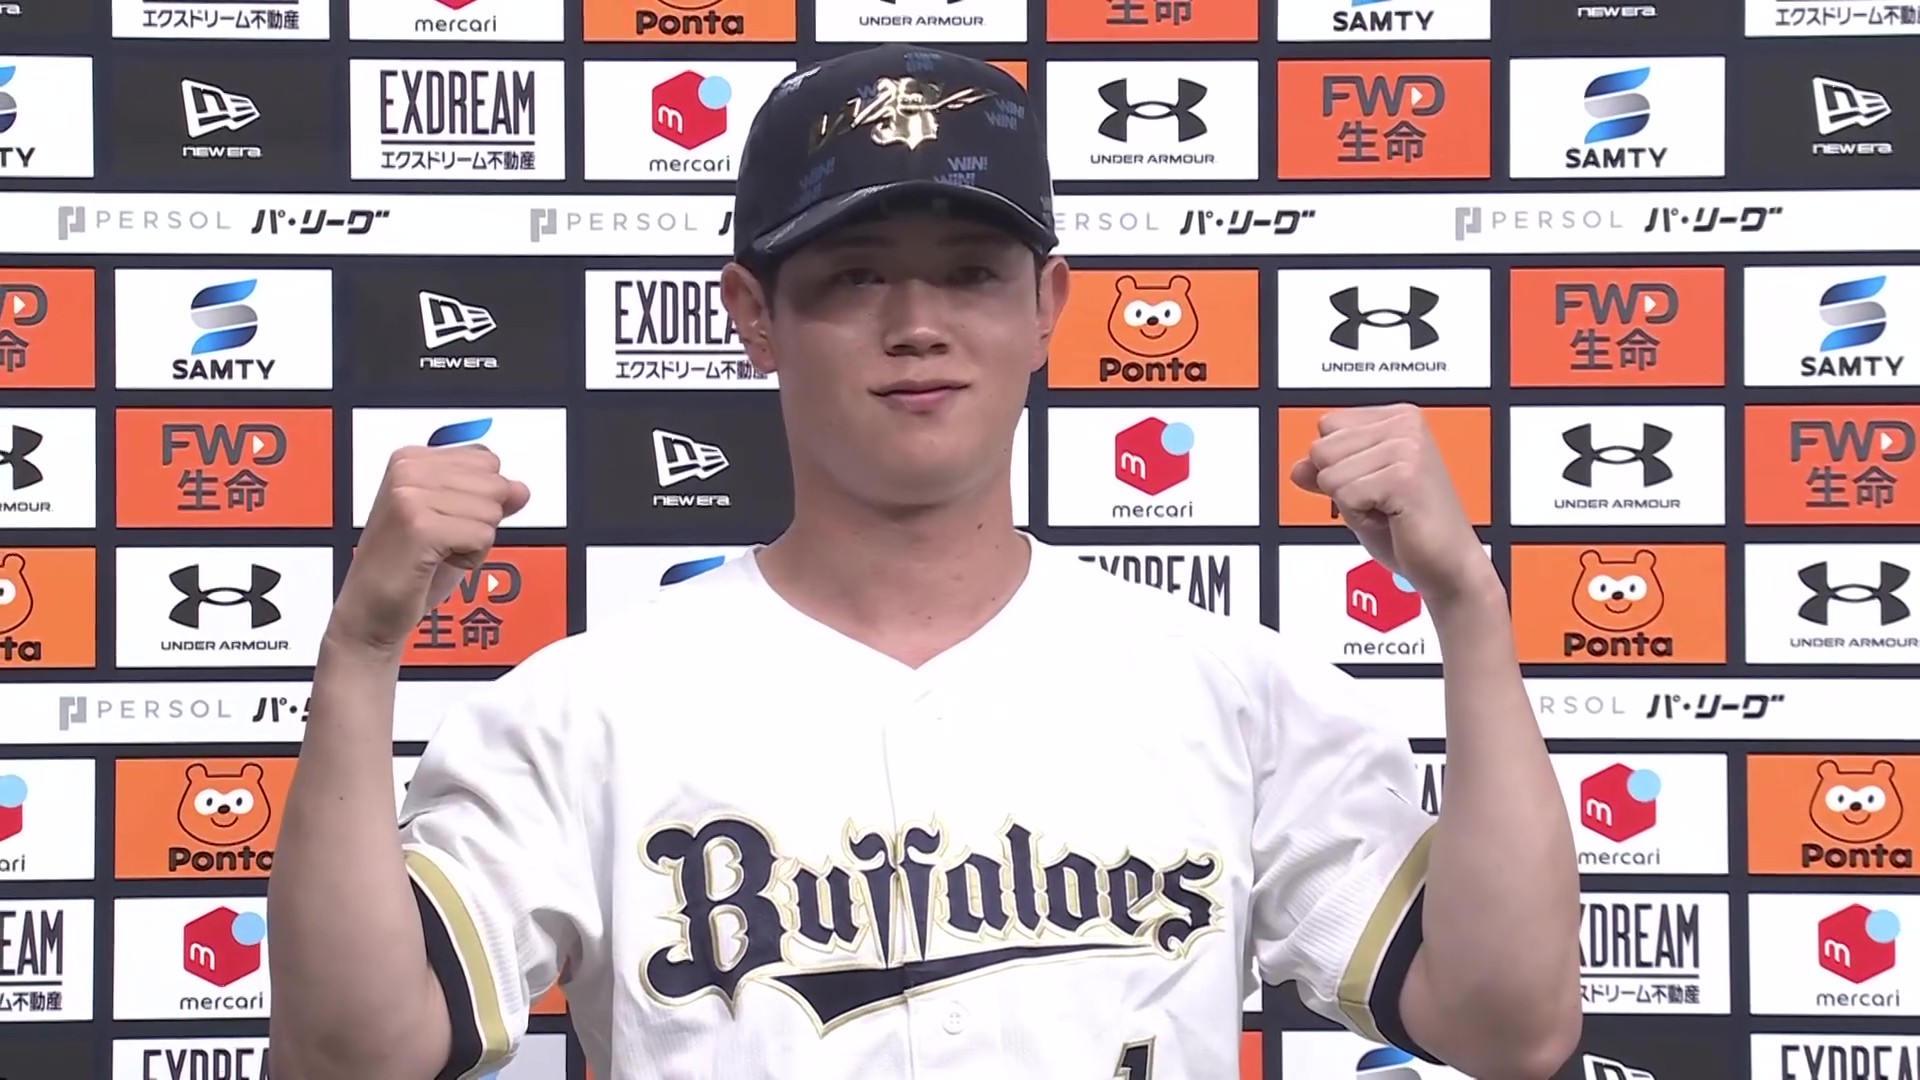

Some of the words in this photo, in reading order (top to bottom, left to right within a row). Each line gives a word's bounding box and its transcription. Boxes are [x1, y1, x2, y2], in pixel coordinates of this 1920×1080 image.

[143, 9, 299, 30] エクスドリーム不動産
[415, 16, 496, 32] mercari
[636, 10, 744, 35] Ponta
[859, 16, 912, 26] UNDER
[916, 16, 983, 26] ARMOUR
[1333, 11, 1434, 32] SAMTY
[1776, 5, 1920, 26] エクスドリーム不動
[380, 70, 535, 135] EXDREAM
[1323, 74, 1445, 117] FWD
[1338, 121, 1426, 163] 生命
[381, 151, 535, 170] エクスドリーム不動産
[650, 156, 730, 172] mercari
[947, 156, 988, 172] WIN!
[1091, 155, 1143, 164] UNDER
[1147, 154, 1214, 164] ARMOUR
[1566, 147, 1667, 169] SAMTY
[97, 211, 230, 229] PERSOL
[251, 209, 390, 235] パ・リーグ
[568, 213, 696, 231] PERSOL
[1056, 213, 1158, 230] ERSOL
[1180, 210, 1316, 235] パ・リーグ
[1493, 211, 1622, 228] PERSOL
[1644, 207, 1783, 232] パ・リーグ
[613, 278, 742, 347] EXDRE
[1556, 282, 1679, 325] FWD
[1570, 329, 1660, 371] 生命
[173, 359, 275, 380] SAMTY
[1100, 356, 1207, 383] Ponta
[1322, 362, 1375, 372] UNDER
[1379, 362, 1446, 371] ARMOUR
[1801, 356, 1904, 377] SAMTY
[162, 424, 287, 465] FWD
[1791, 421, 1916, 462] FWD
[178, 469, 268, 512] 生命
[1806, 466, 1897, 508] 生命
[0, 502, 50, 512] MOUR
[1113, 502, 1192, 517] mercari
[1555, 499, 1608, 508] UNDER
[1612, 499, 1680, 508] ARMOUR
[161, 641, 216, 650] UNDER
[219, 641, 288, 650] ARMOUR
[1344, 639, 1424, 654] mercari
[1564, 628, 1673, 657] Ponta
[1791, 638, 1845, 647] UNDER
[1849, 638, 1918, 647] ARMOUR
[98, 700, 230, 718] PERSOL
[1541, 696, 1624, 714] RSOL
[1646, 694, 1785, 719] パ・リーグ
[1578, 848, 1661, 866] mercari
[1802, 843, 1912, 868] Ponta
[638, 812, 1225, 1018] Buffaloes
[1580, 903, 1700, 969] DREAM
[180, 992, 263, 1010] mercari
[1817, 990, 1899, 1006] mercari
